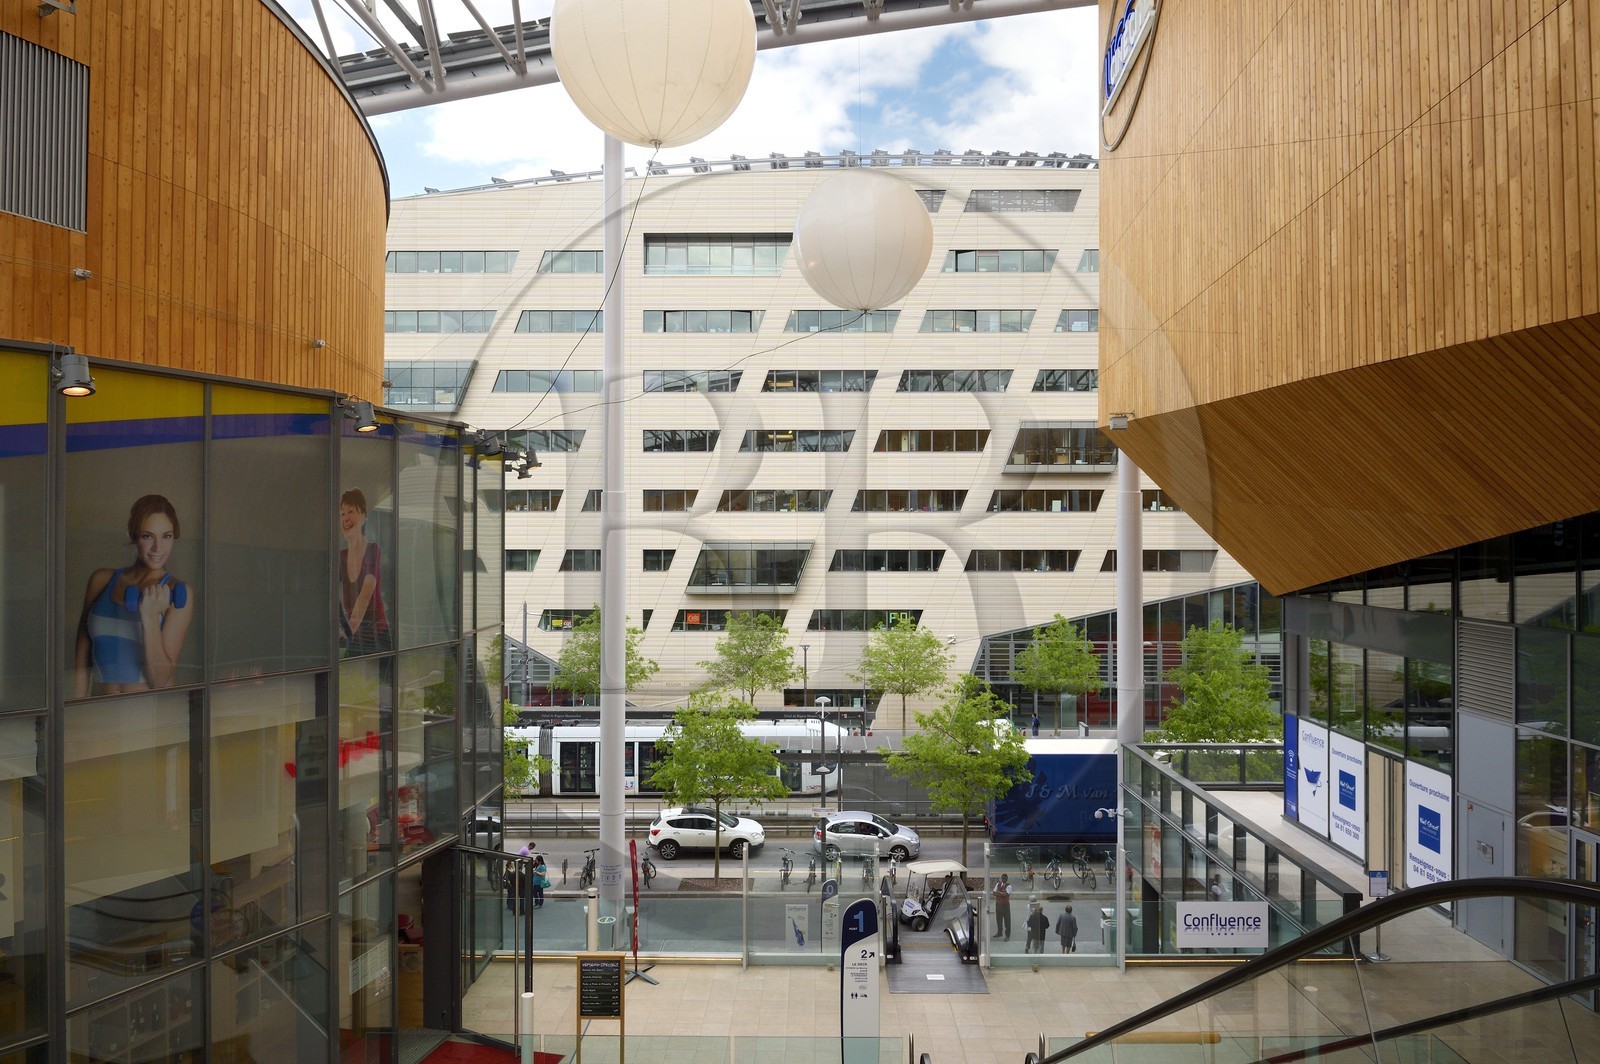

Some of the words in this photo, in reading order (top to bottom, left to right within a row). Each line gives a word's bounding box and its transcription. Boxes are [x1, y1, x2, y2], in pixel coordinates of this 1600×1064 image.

[1056, 784, 1079, 799] M
[1408, 778, 1429, 793] Ouverture
[1429, 788, 1450, 802] prochaine
[853, 910, 864, 933] 1
[1183, 913, 1262, 927] Confluence
[860, 949, 868, 959] 2
